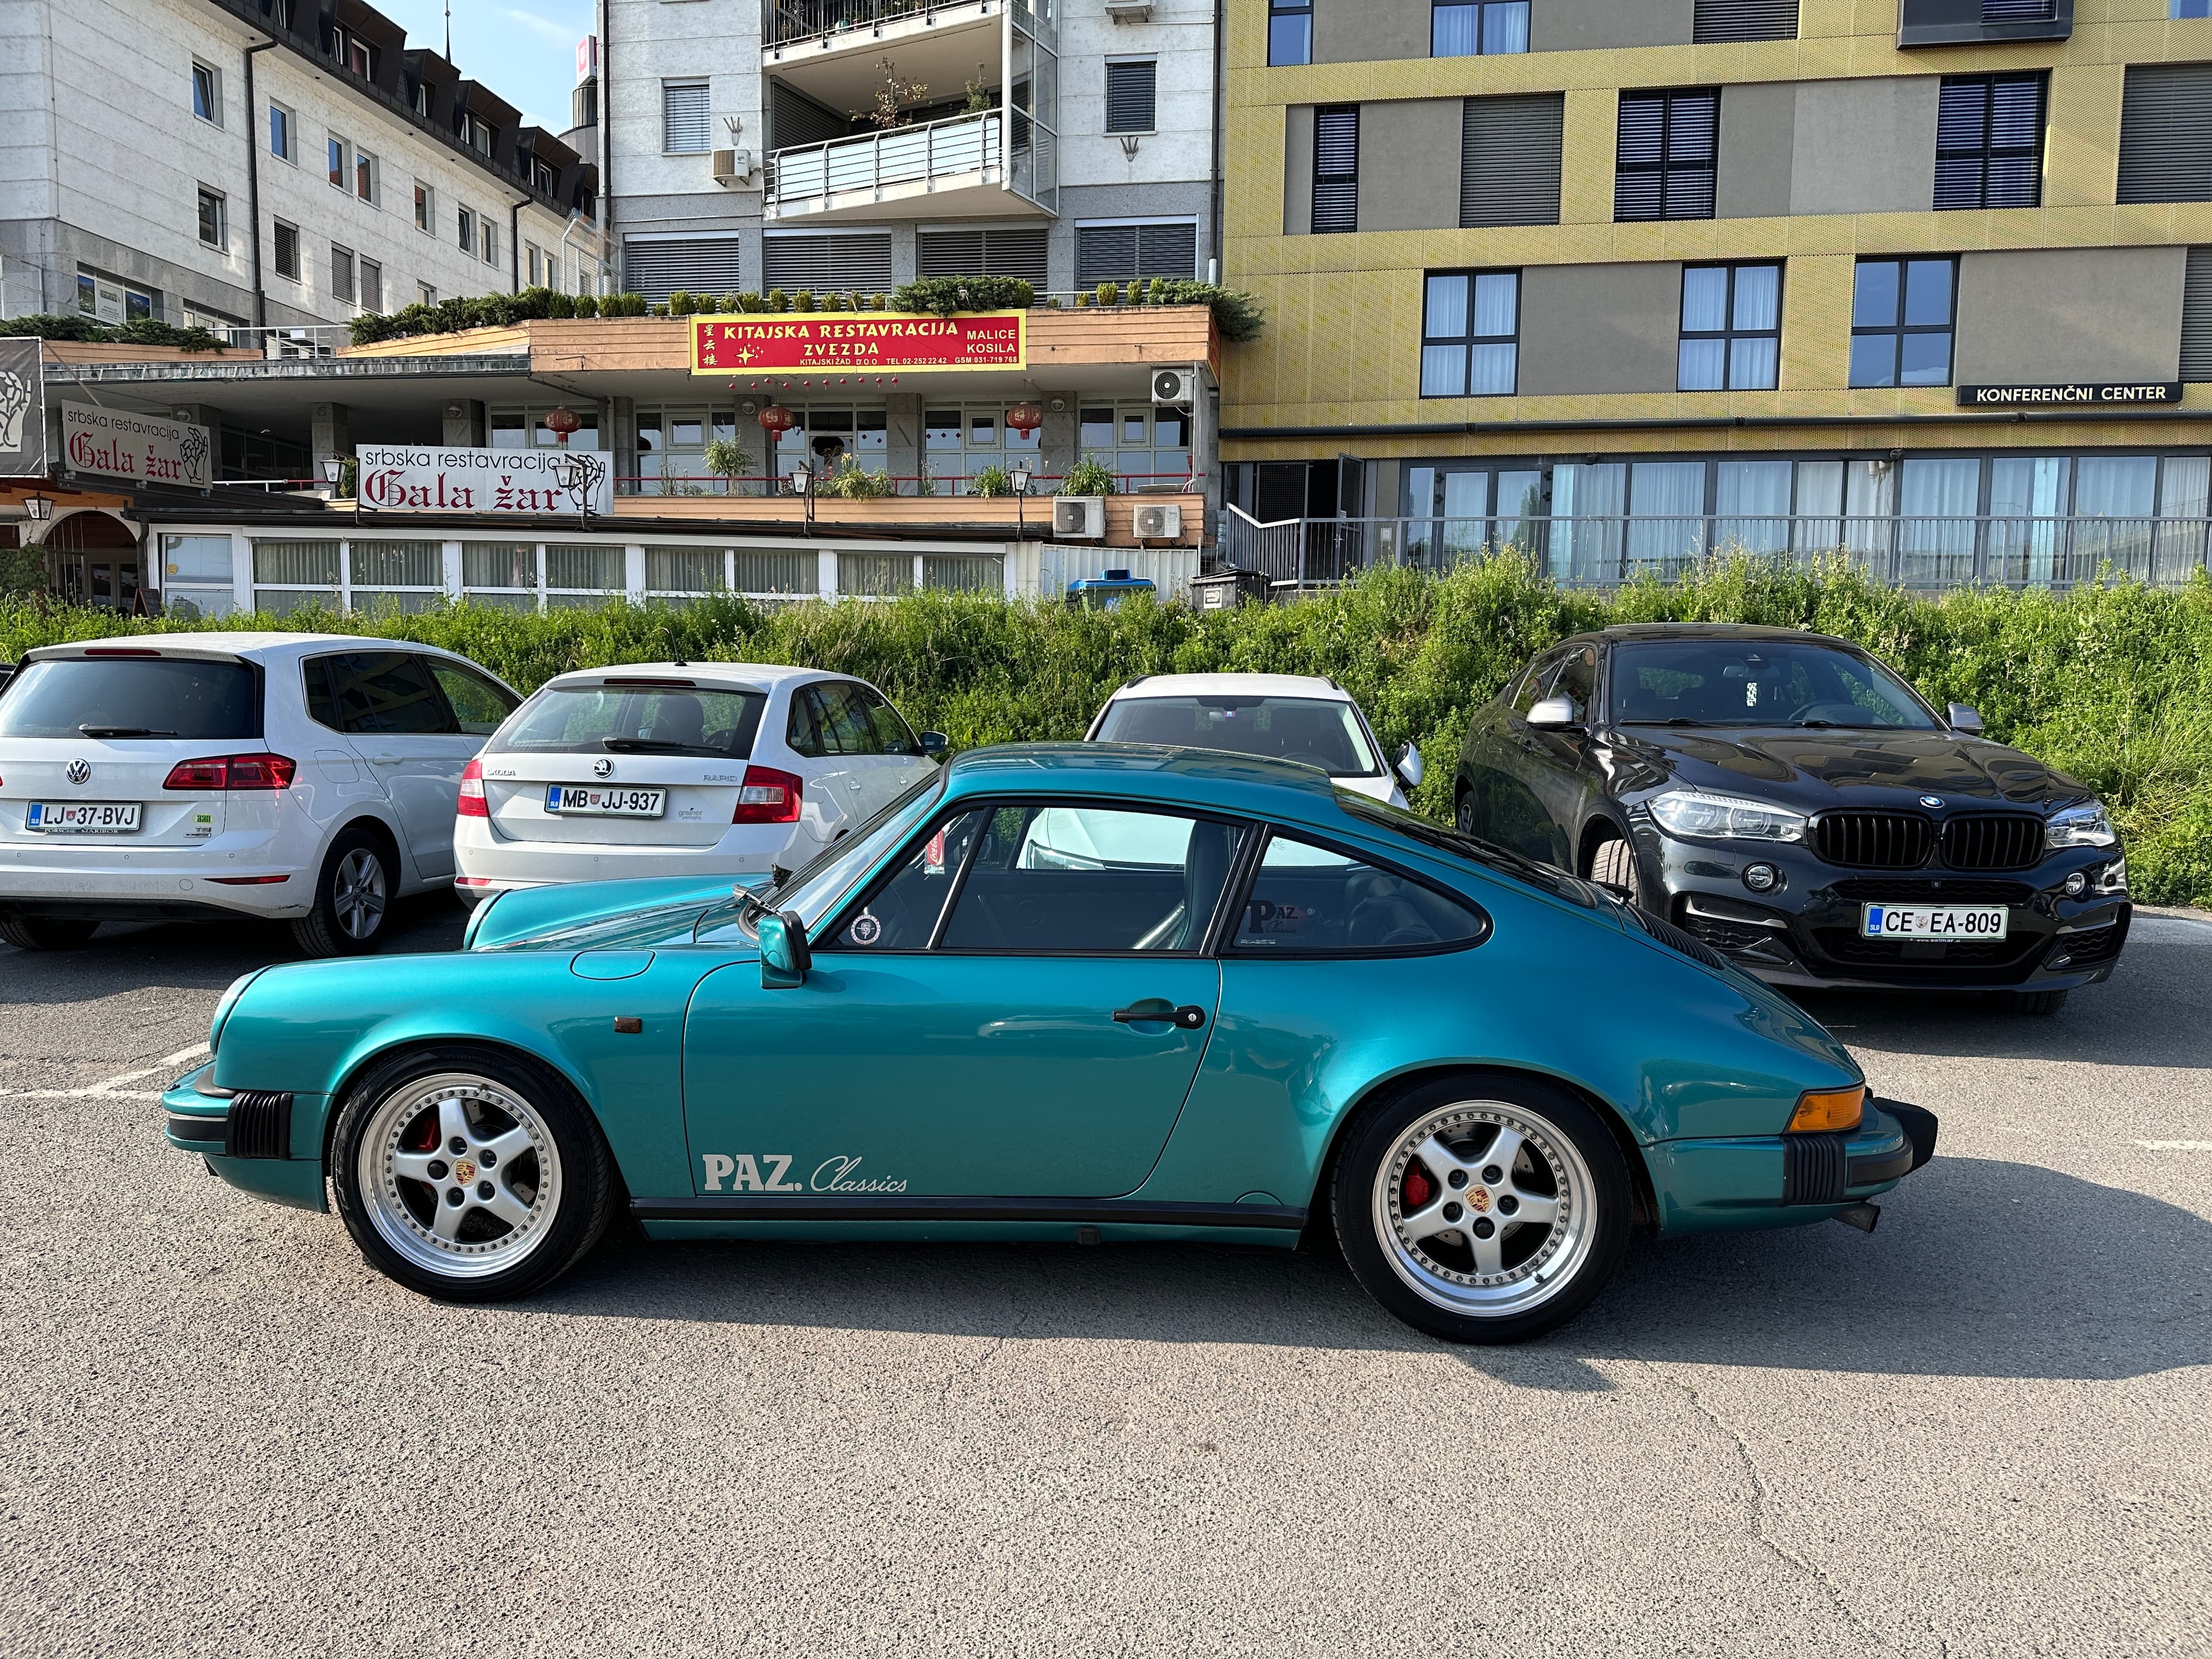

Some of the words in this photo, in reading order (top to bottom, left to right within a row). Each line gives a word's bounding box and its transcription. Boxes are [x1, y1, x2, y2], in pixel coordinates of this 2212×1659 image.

[724, 325, 810, 340] KITAJSKA
[819, 321, 959, 338] RESTAVRACIJA
[967, 329, 1016, 340] MALICE
[804, 342, 879, 356] ZVEZDA
[967, 343, 1016, 354] KOSILA
[835, 357, 851, 365] ŽAD
[1976, 385, 2093, 402] KONFERENČNI
[2101, 387, 2166, 400] CENTER
[68, 410, 108, 427] srbska
[111, 418, 180, 441] restavracija
[69, 431, 135, 474] Gala
[145, 445, 182, 479] žar
[365, 448, 430, 467] srbska
[437, 451, 562, 474] restavracija
[365, 469, 475, 510] Gala
[493, 475, 563, 511] žar
[562, 790, 588, 808] MB
[602, 791, 660, 810] JJ-937
[44, 807, 65, 824] LJ
[77, 807, 135, 825] 37-BVJ
[678, 808, 703, 817] greiner
[1885, 911, 1914, 932] CE
[1930, 912, 2002, 933] EA-809
[702, 1154, 803, 1192] PAZ.
[809, 1156, 908, 1192] Classics
